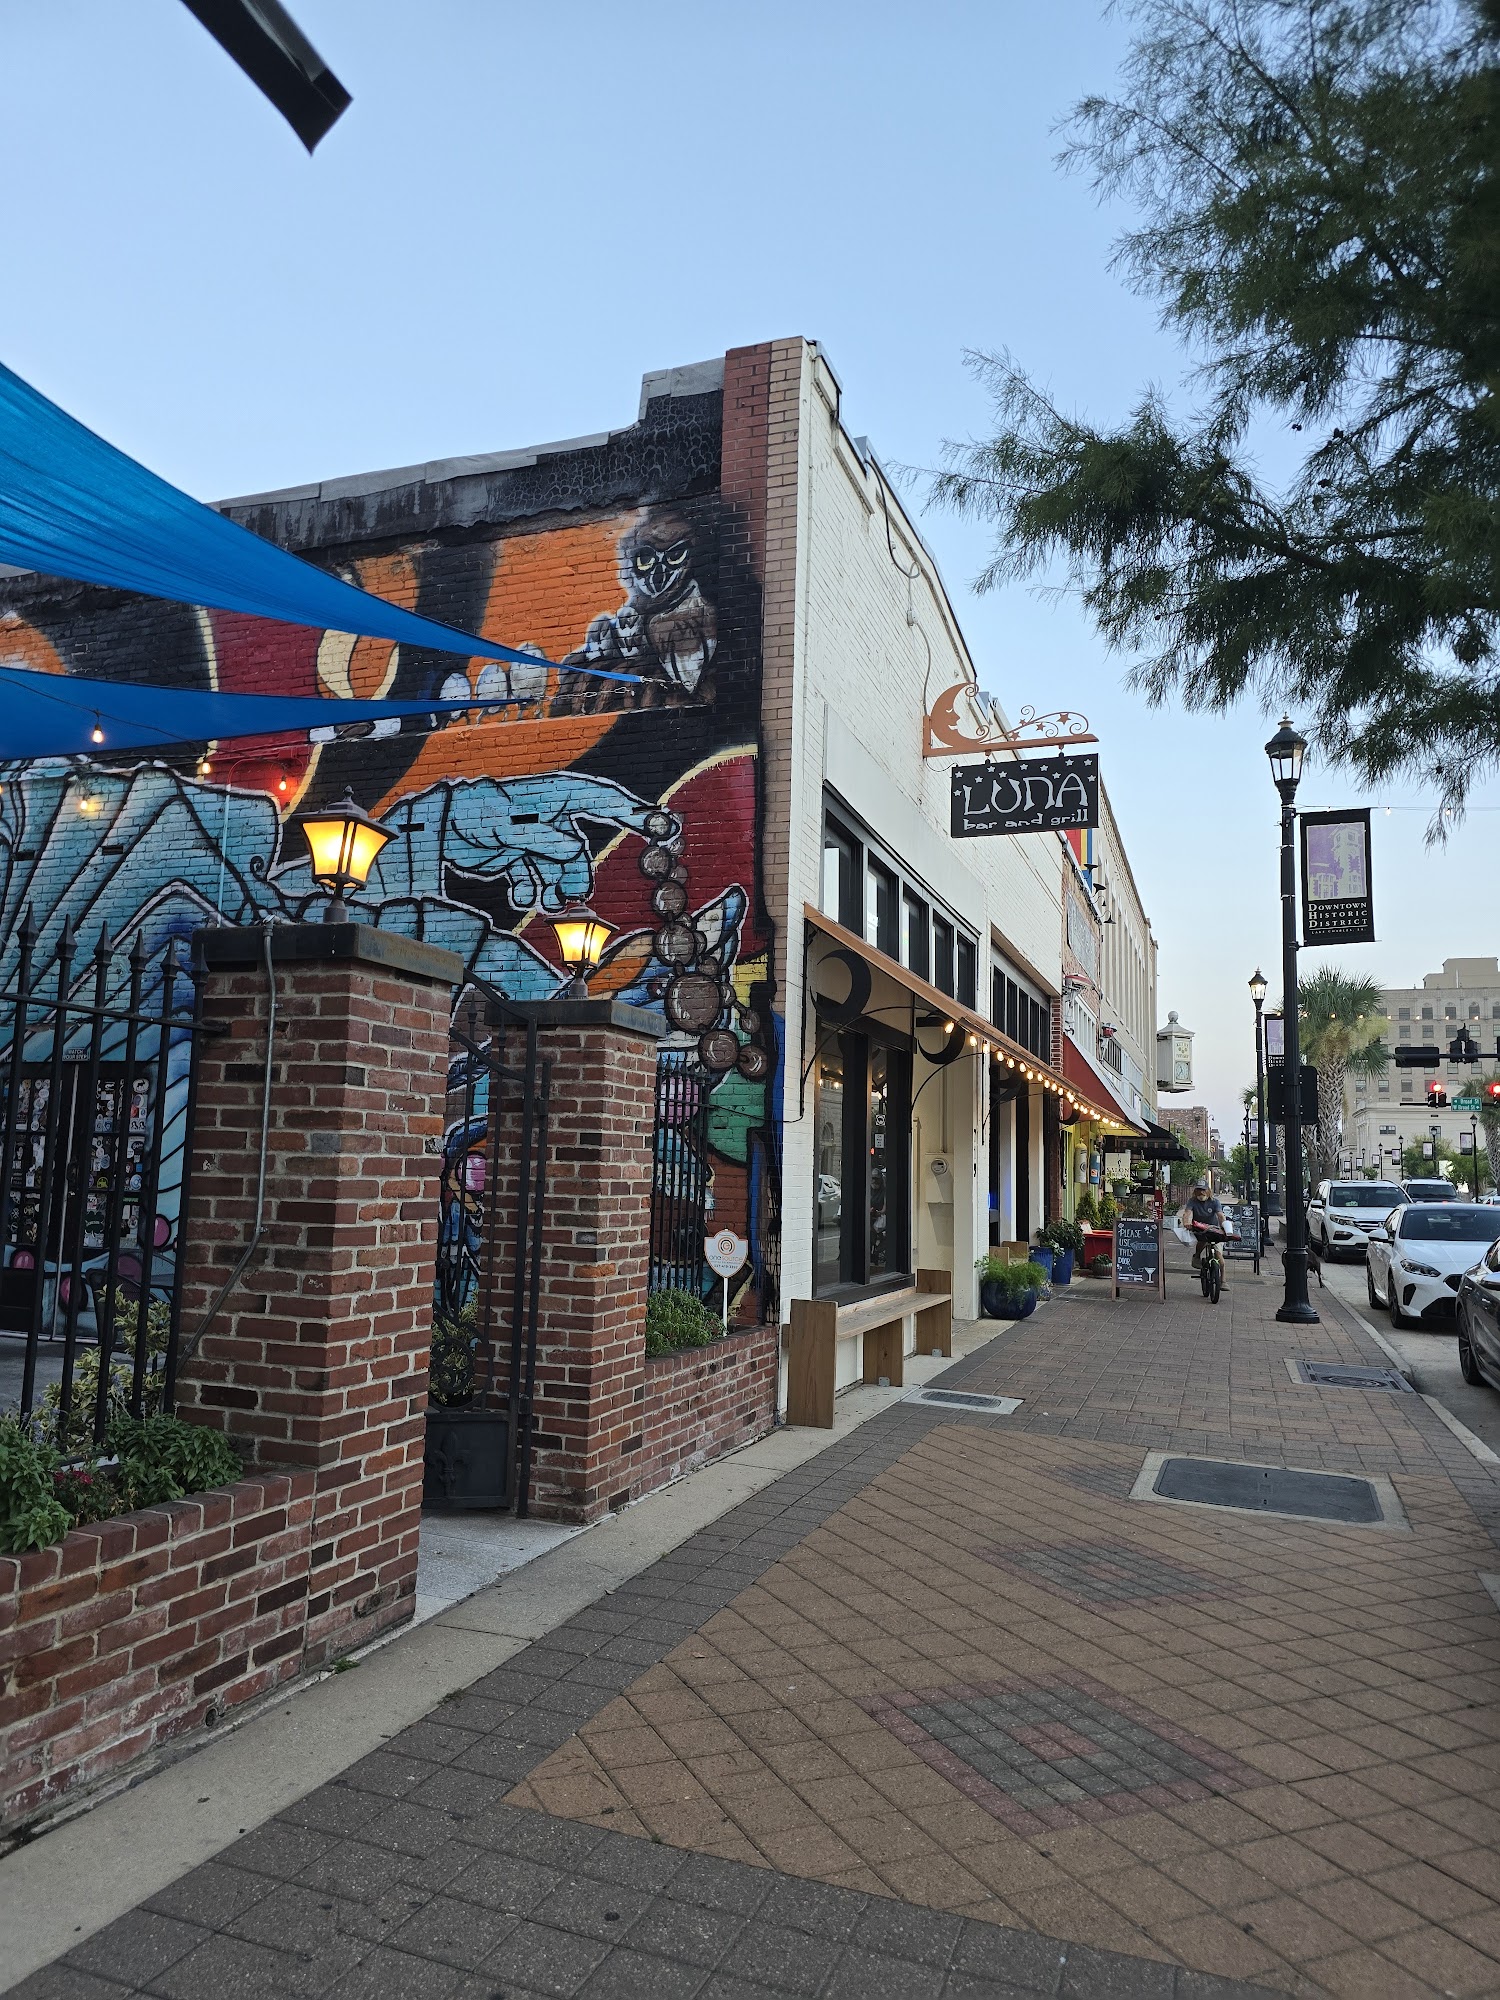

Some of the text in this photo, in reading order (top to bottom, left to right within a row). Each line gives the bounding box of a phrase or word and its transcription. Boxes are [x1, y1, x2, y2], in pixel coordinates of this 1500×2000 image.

[962, 772, 1089, 815] LUNA
[963, 808, 1089, 831] bar and grill
[1308, 903, 1367, 911] DOWNTOWN
[1308, 910, 1368, 919] HISTORIC
[1309, 918, 1368, 928] DISTRICT
[1119, 1228, 1142, 1238] PLEASE
[1119, 1239, 1131, 1247] USE
[1118, 1248, 1134, 1256] THIS
[1117, 1257, 1131, 1266] DOOR
